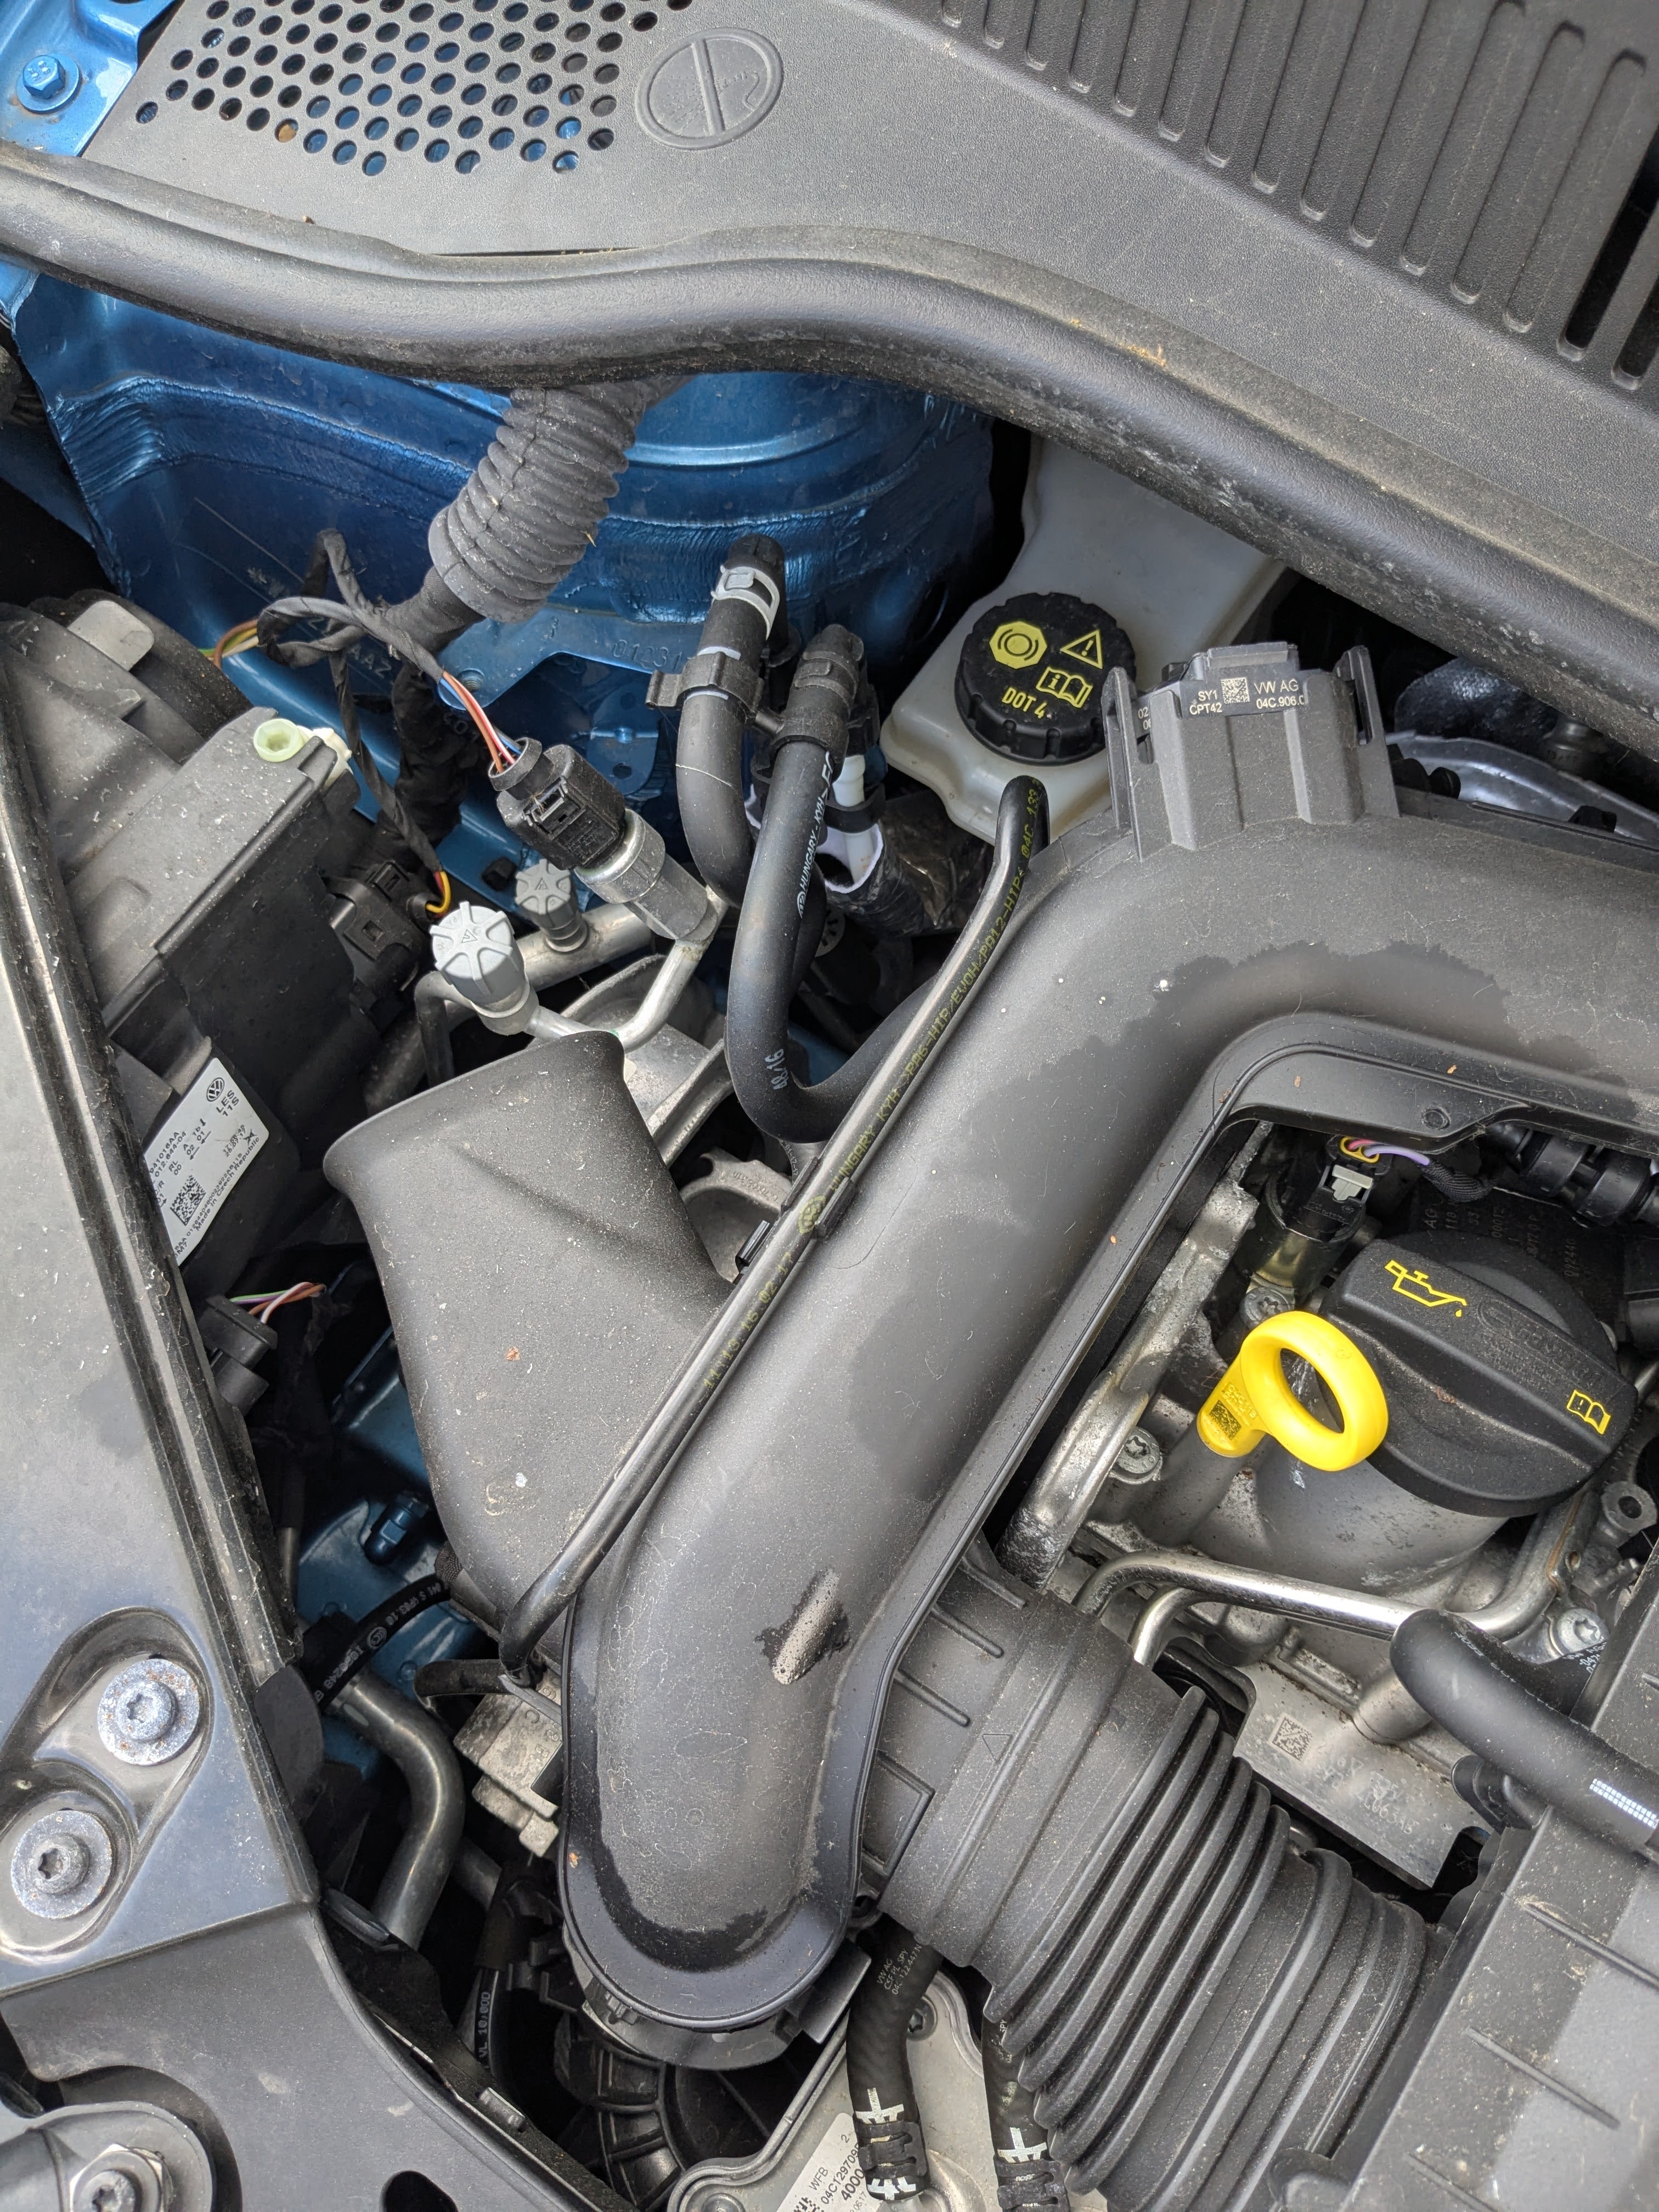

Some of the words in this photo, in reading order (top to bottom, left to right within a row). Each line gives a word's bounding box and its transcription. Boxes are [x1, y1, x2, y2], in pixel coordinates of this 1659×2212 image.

[1198, 689, 1218, 701] SY1
[1254, 680, 1276, 695] VW
[1280, 678, 1299, 693] AG
[1002, 687, 1036, 712] DOT
[1034, 703, 1047, 719] 4
[1189, 702, 1223, 715] CPT42
[800, 831, 820, 890] HUNGARY
[811, 795, 826, 824] KYH
[216, 1090, 234, 1113] LES
[222, 1097, 239, 1116] 11S
[876, 1088, 900, 1121] KYH
[174, 1164, 181, 1175] 00
[187, 1144, 194, 1155] 02
[196, 1131, 204, 1141] 01
[168, 1161, 178, 1171] RL
[194, 1205, 212, 1231] Made
[216, 1171, 234, 1197] Czech
[234, 1136, 259, 1171] Republic
[897, 1949, 907, 1963] SPY
[809, 2167, 828, 2190] WFB
[840, 2134, 849, 2143] 2
